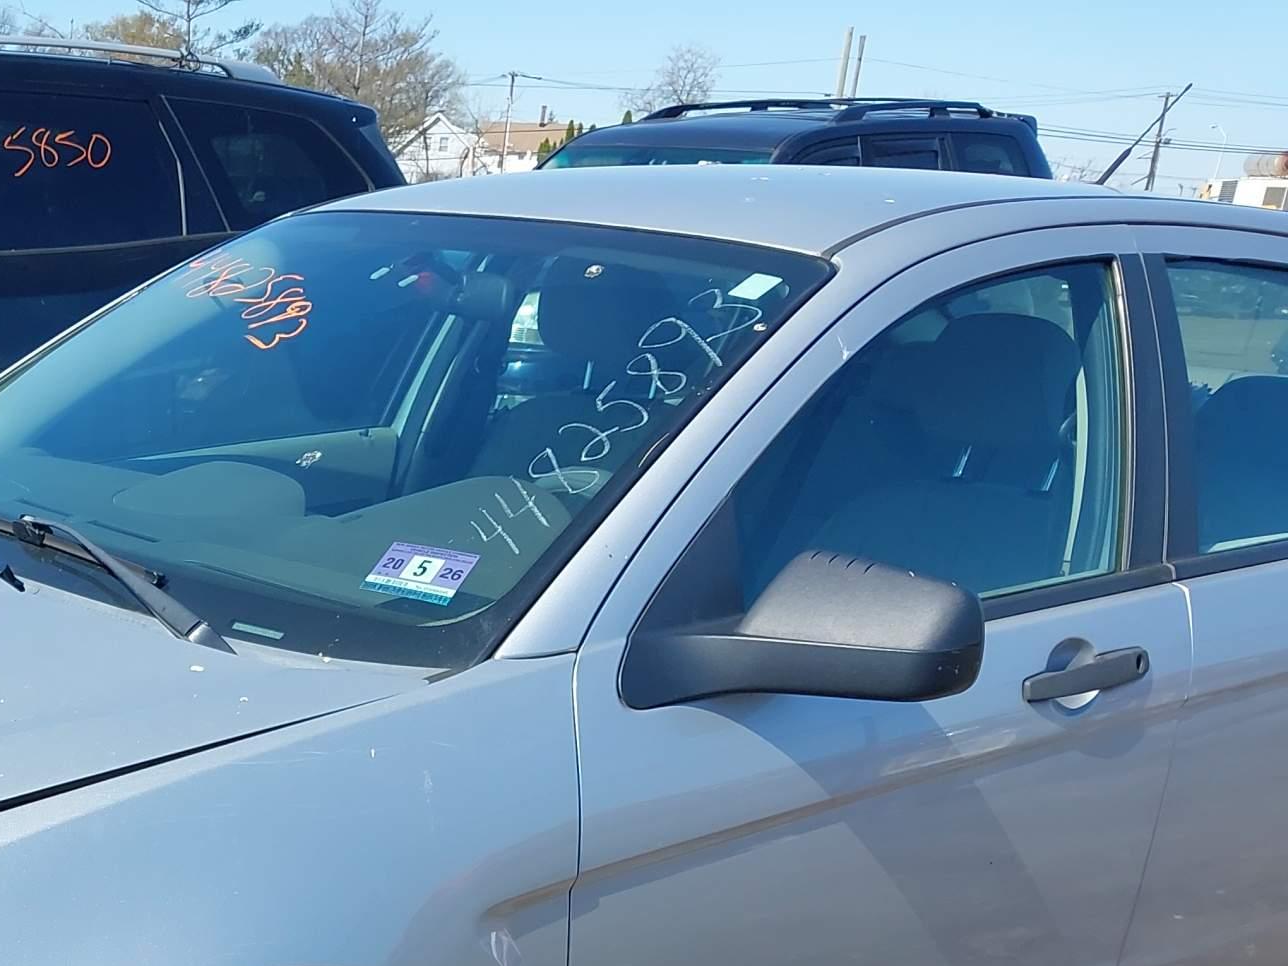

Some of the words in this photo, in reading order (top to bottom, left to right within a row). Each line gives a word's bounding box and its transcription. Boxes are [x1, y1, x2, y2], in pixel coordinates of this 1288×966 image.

[3, 125, 112, 177] 5850
[470, 288, 763, 555] 44825893
[382, 557, 405, 570] 20
[412, 559, 432, 577] 5
[439, 567, 464, 581] 26
